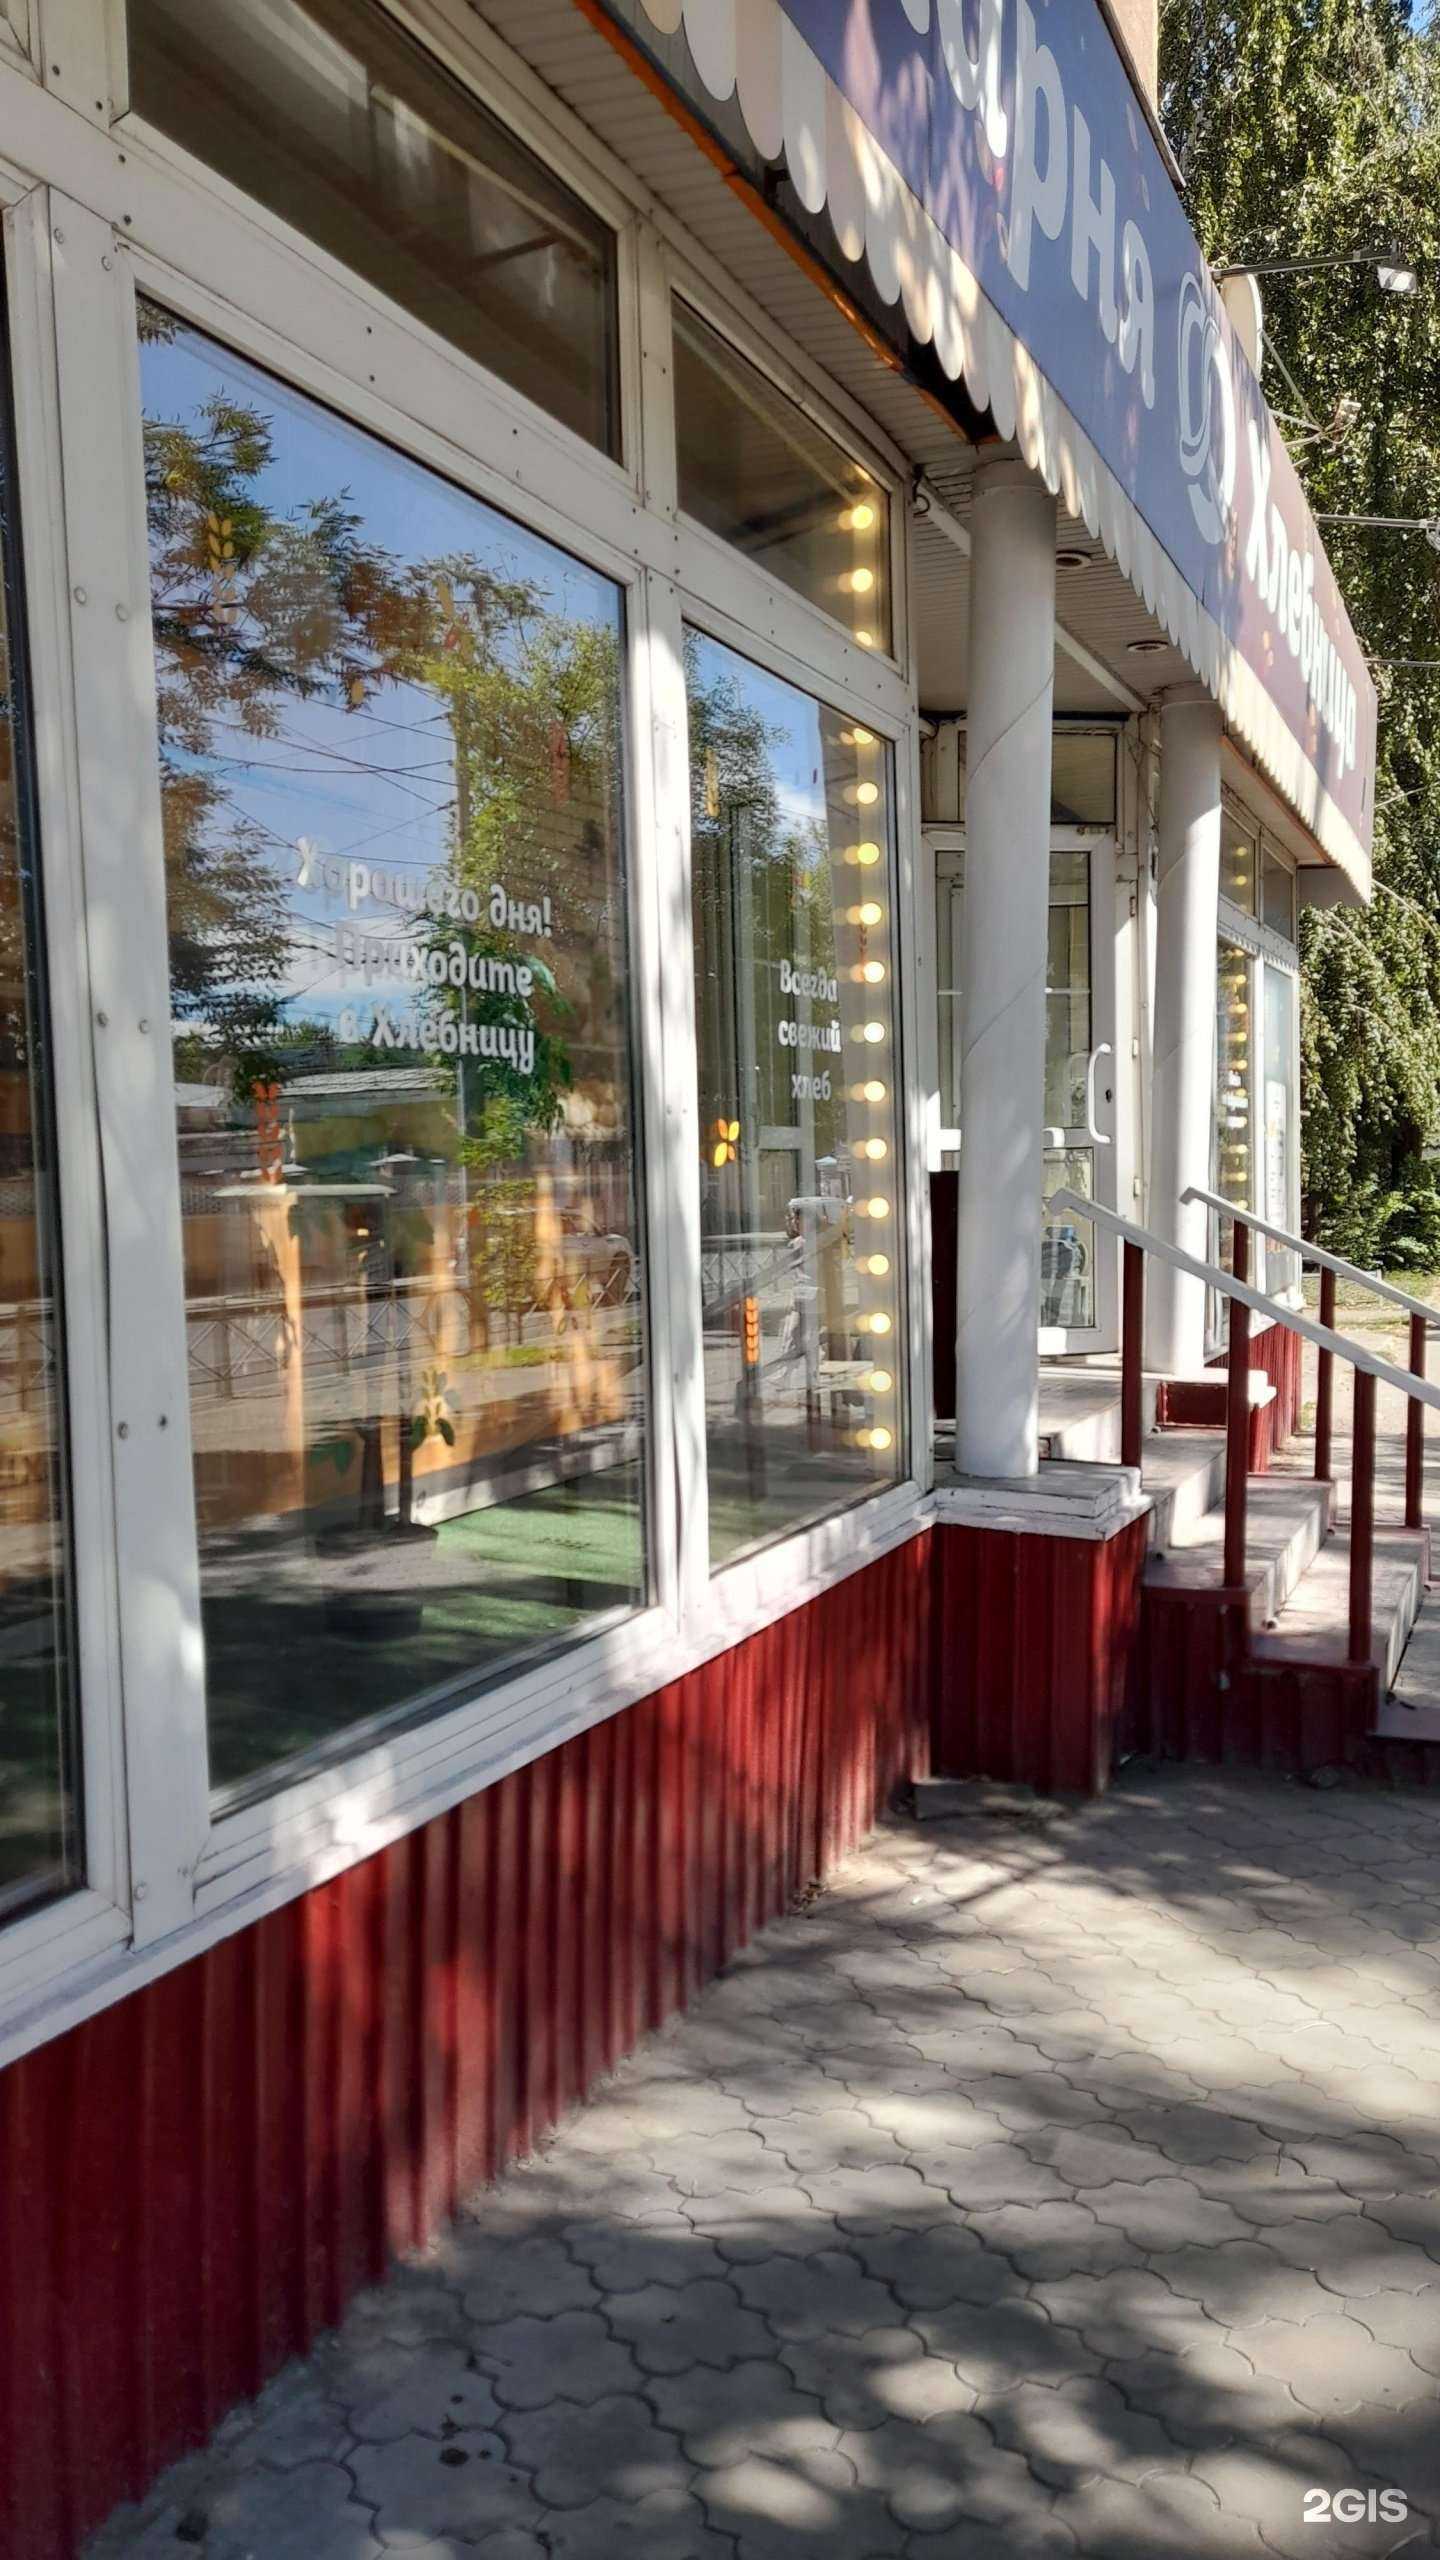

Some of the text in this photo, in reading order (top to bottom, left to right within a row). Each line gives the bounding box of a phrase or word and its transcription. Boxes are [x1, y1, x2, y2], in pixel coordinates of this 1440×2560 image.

[489, 883, 552, 938] дня!
[779, 959, 838, 1002] Всегда
[371, 1001, 534, 1074] Хлебницу
[777, 1019, 841, 1053] свежий
[791, 1070, 831, 1101] хлеб
